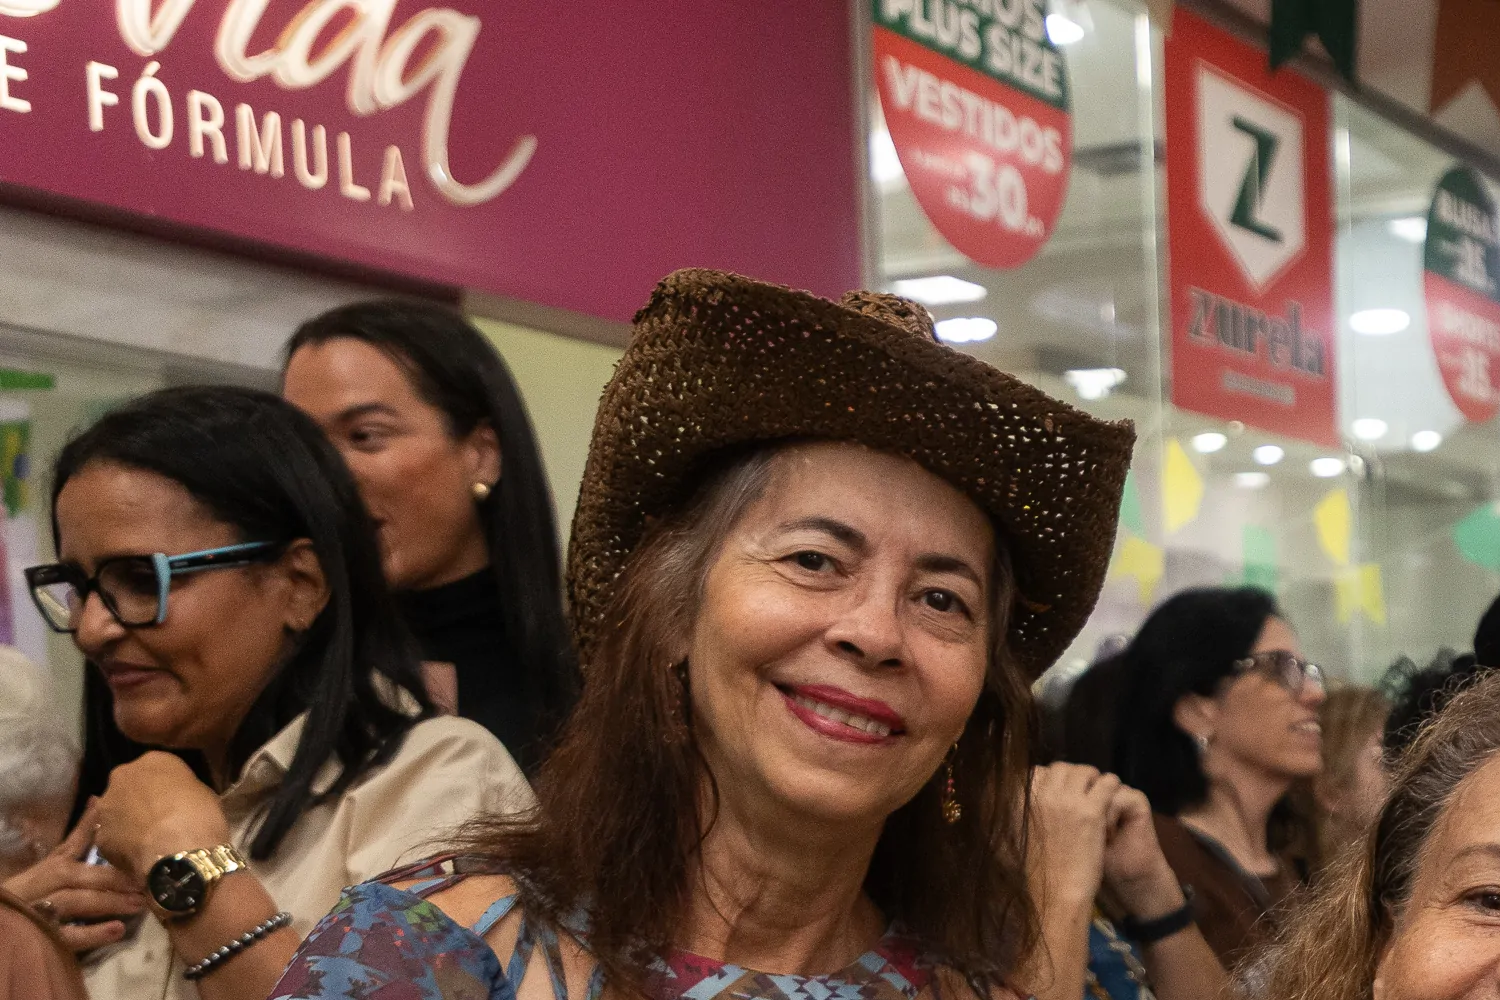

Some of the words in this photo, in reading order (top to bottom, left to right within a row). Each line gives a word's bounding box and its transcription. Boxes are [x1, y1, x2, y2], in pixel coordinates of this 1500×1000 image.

[882, 54, 1064, 175] VESTIDOS
[985, 22, 1065, 98] SIZE
[86, 61, 414, 211] FÓRMULA
[1228, 112, 1285, 244] Z
